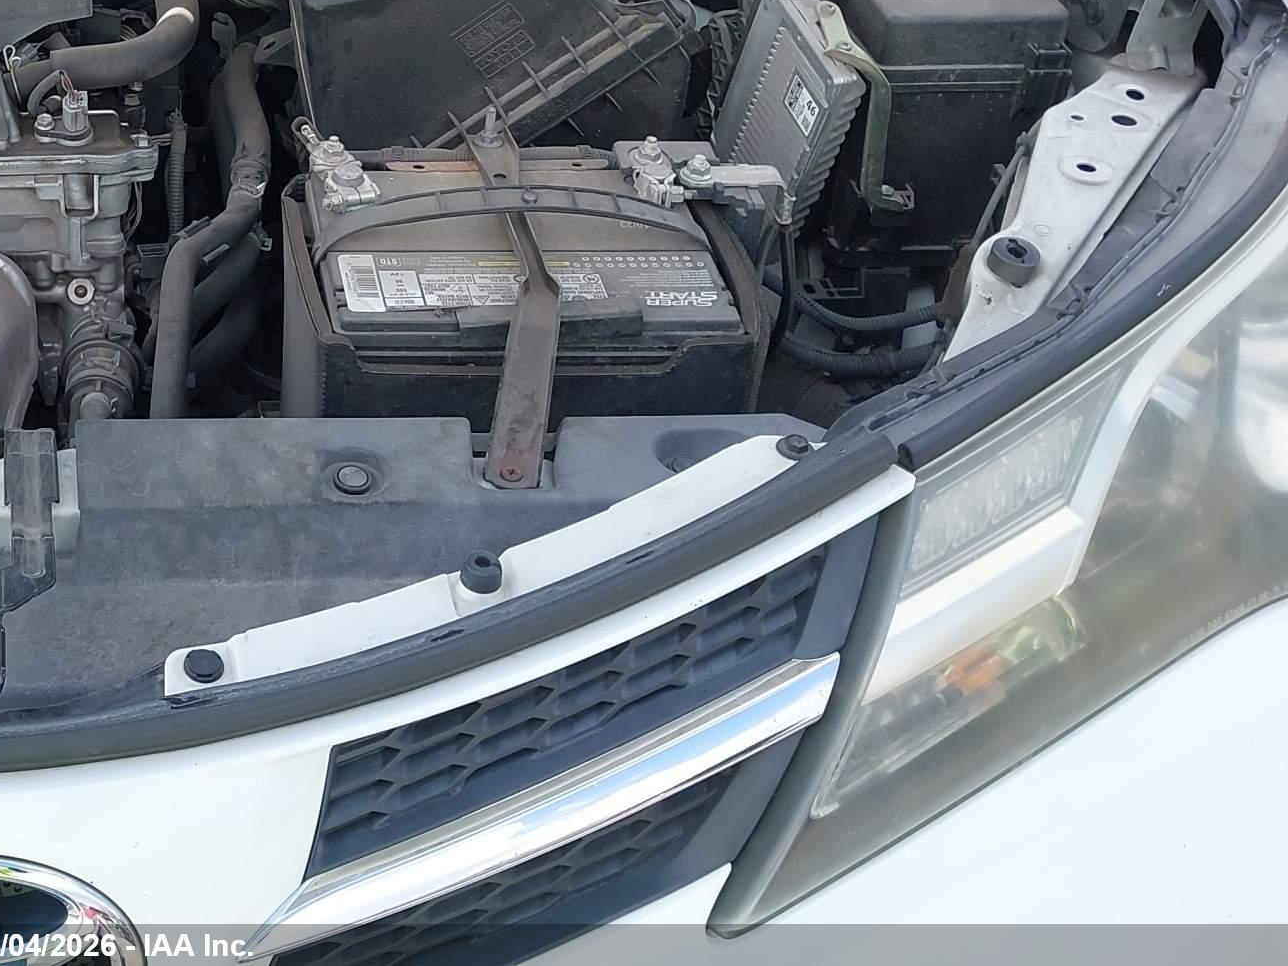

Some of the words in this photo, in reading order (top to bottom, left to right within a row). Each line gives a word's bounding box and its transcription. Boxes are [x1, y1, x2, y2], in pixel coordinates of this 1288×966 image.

[805, 98, 817, 117] 46
[644, 291, 718, 301] START
[646, 298, 713, 307] SUPER
